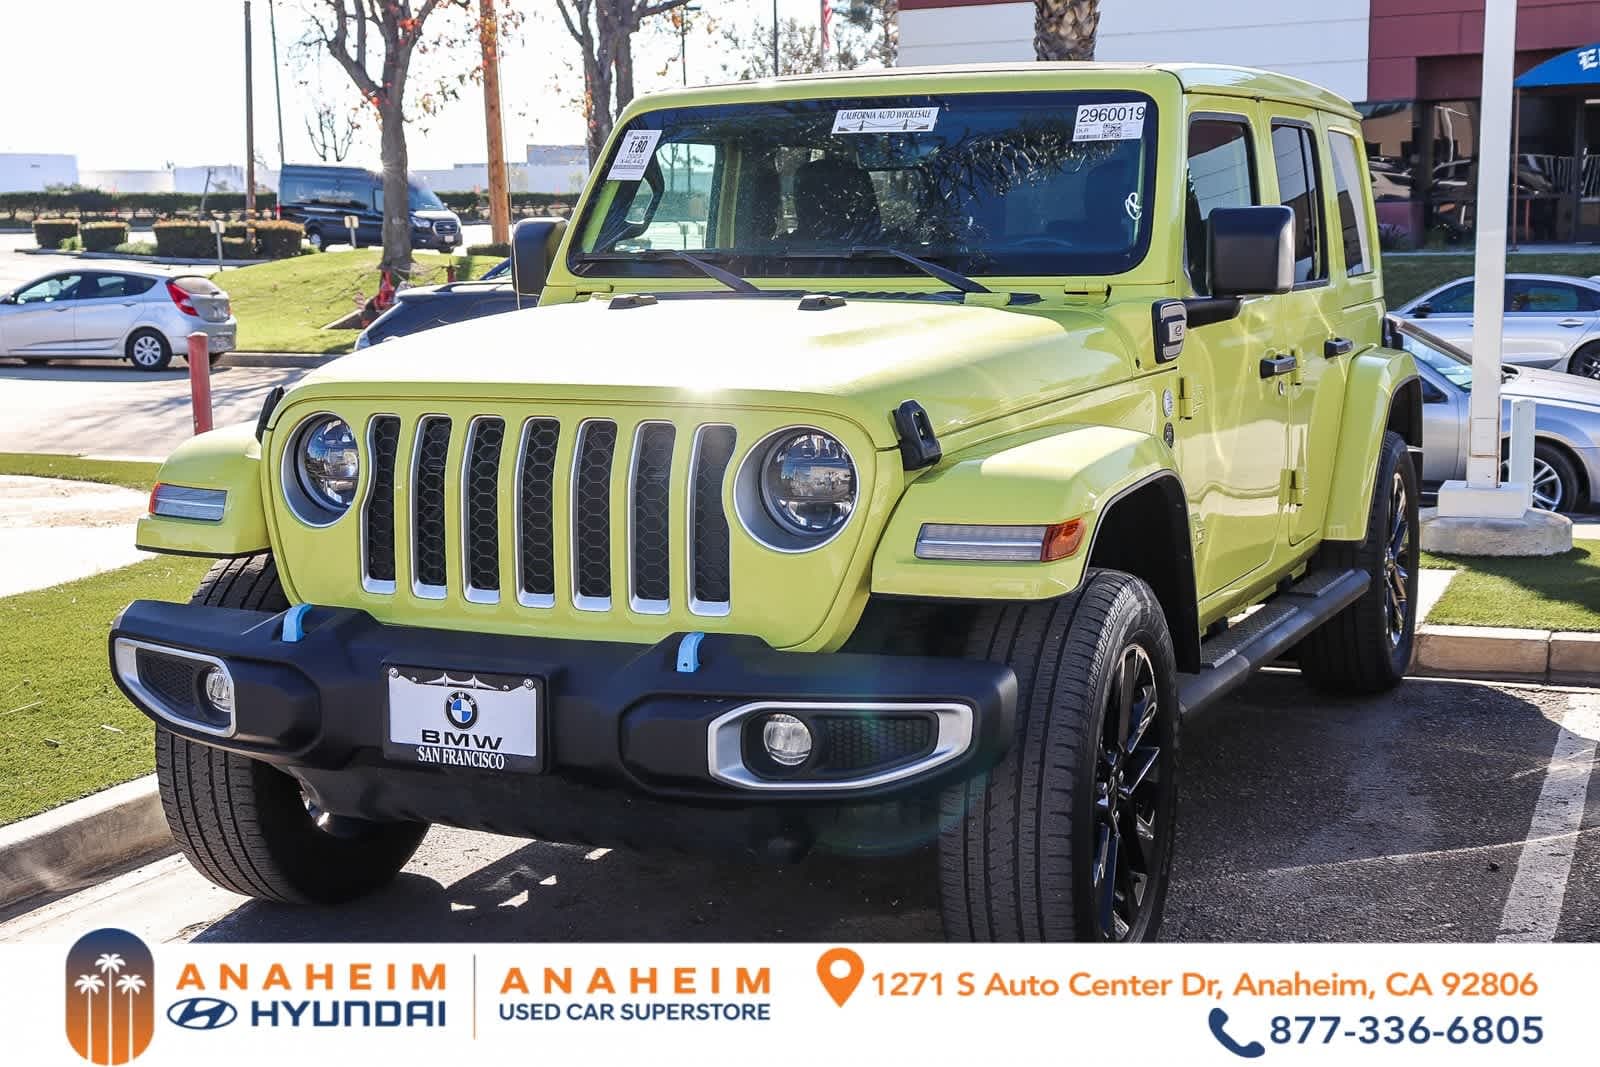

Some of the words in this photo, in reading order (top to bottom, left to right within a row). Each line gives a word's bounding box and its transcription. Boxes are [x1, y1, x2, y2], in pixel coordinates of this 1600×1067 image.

[841, 111, 876, 120] CALIFORNIA
[878, 110, 896, 120] AUTO
[896, 109, 931, 119] WHOLESALE
[1080, 106, 1146, 122] 2960019
[421, 729, 503, 751] BMW
[417, 746, 440, 763] SAN
[442, 748, 505, 770] FRANCISCO
